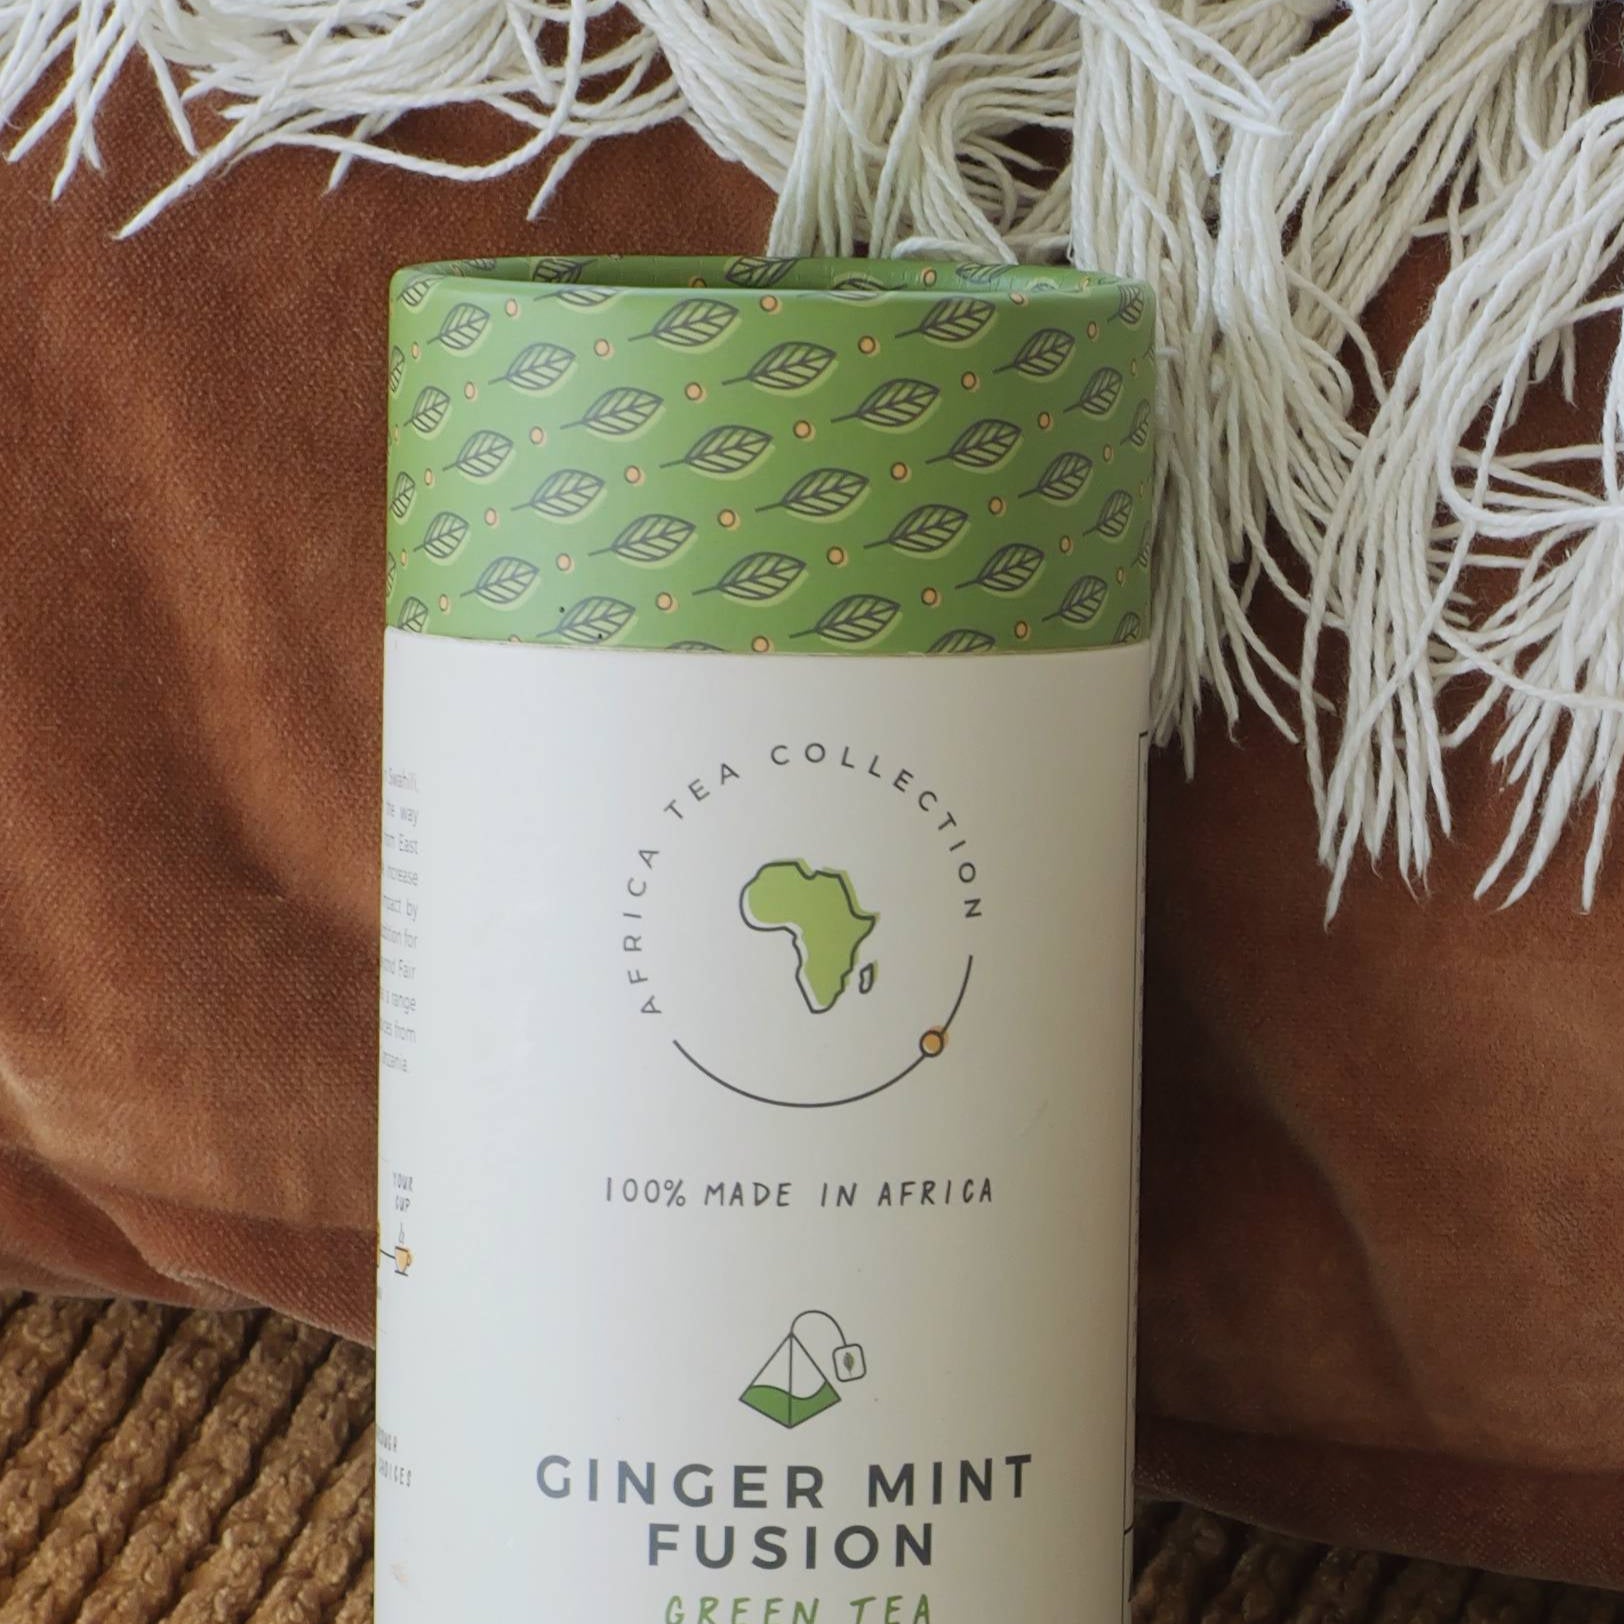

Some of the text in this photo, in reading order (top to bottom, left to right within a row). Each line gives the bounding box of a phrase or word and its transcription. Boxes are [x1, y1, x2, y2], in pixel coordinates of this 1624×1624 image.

[622, 742, 983, 1015] AFRICA TEA COLLECTION
[606, 1176, 992, 1208] 100% MADE IN AFRICA
[536, 1453, 1032, 1509] GINGER MINT
[648, 1522, 933, 1571] FUSION
